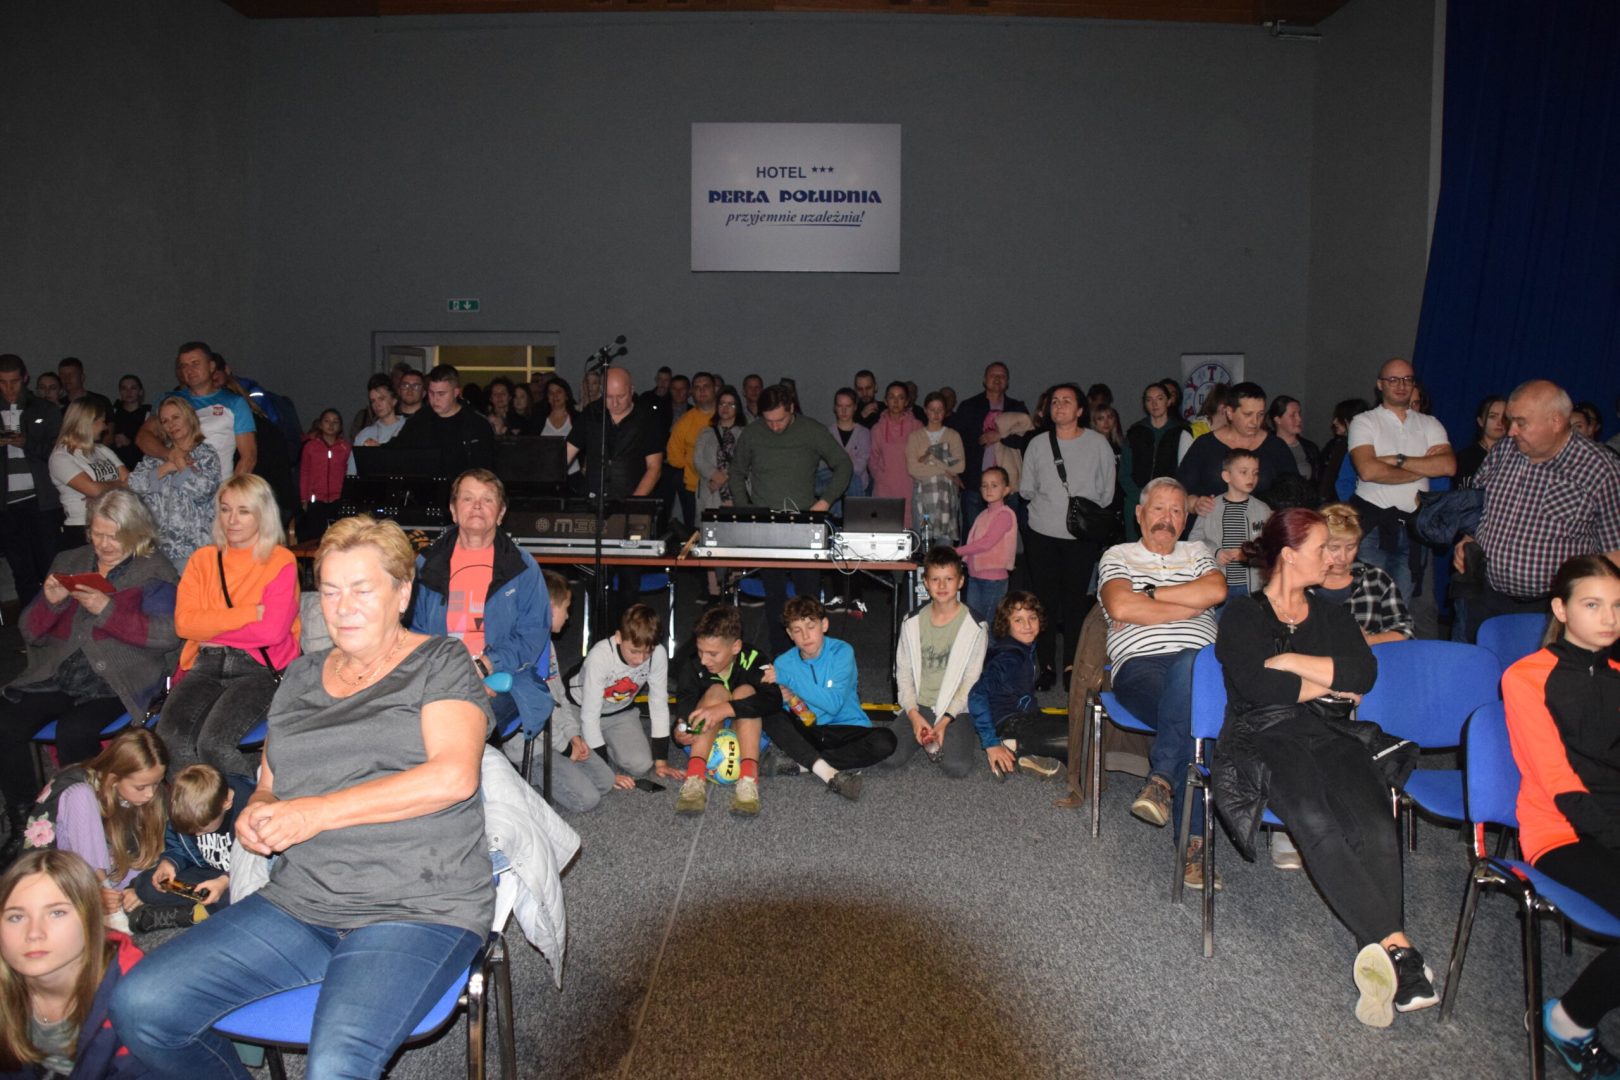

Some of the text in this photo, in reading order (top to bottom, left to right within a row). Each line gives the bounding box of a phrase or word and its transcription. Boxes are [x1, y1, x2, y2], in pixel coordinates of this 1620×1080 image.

[756, 166, 807, 179] HOTEL
[708, 190, 882, 204] PERŁA POŁUDNIA
[725, 210, 866, 227] przyjemnie uzależnia!
